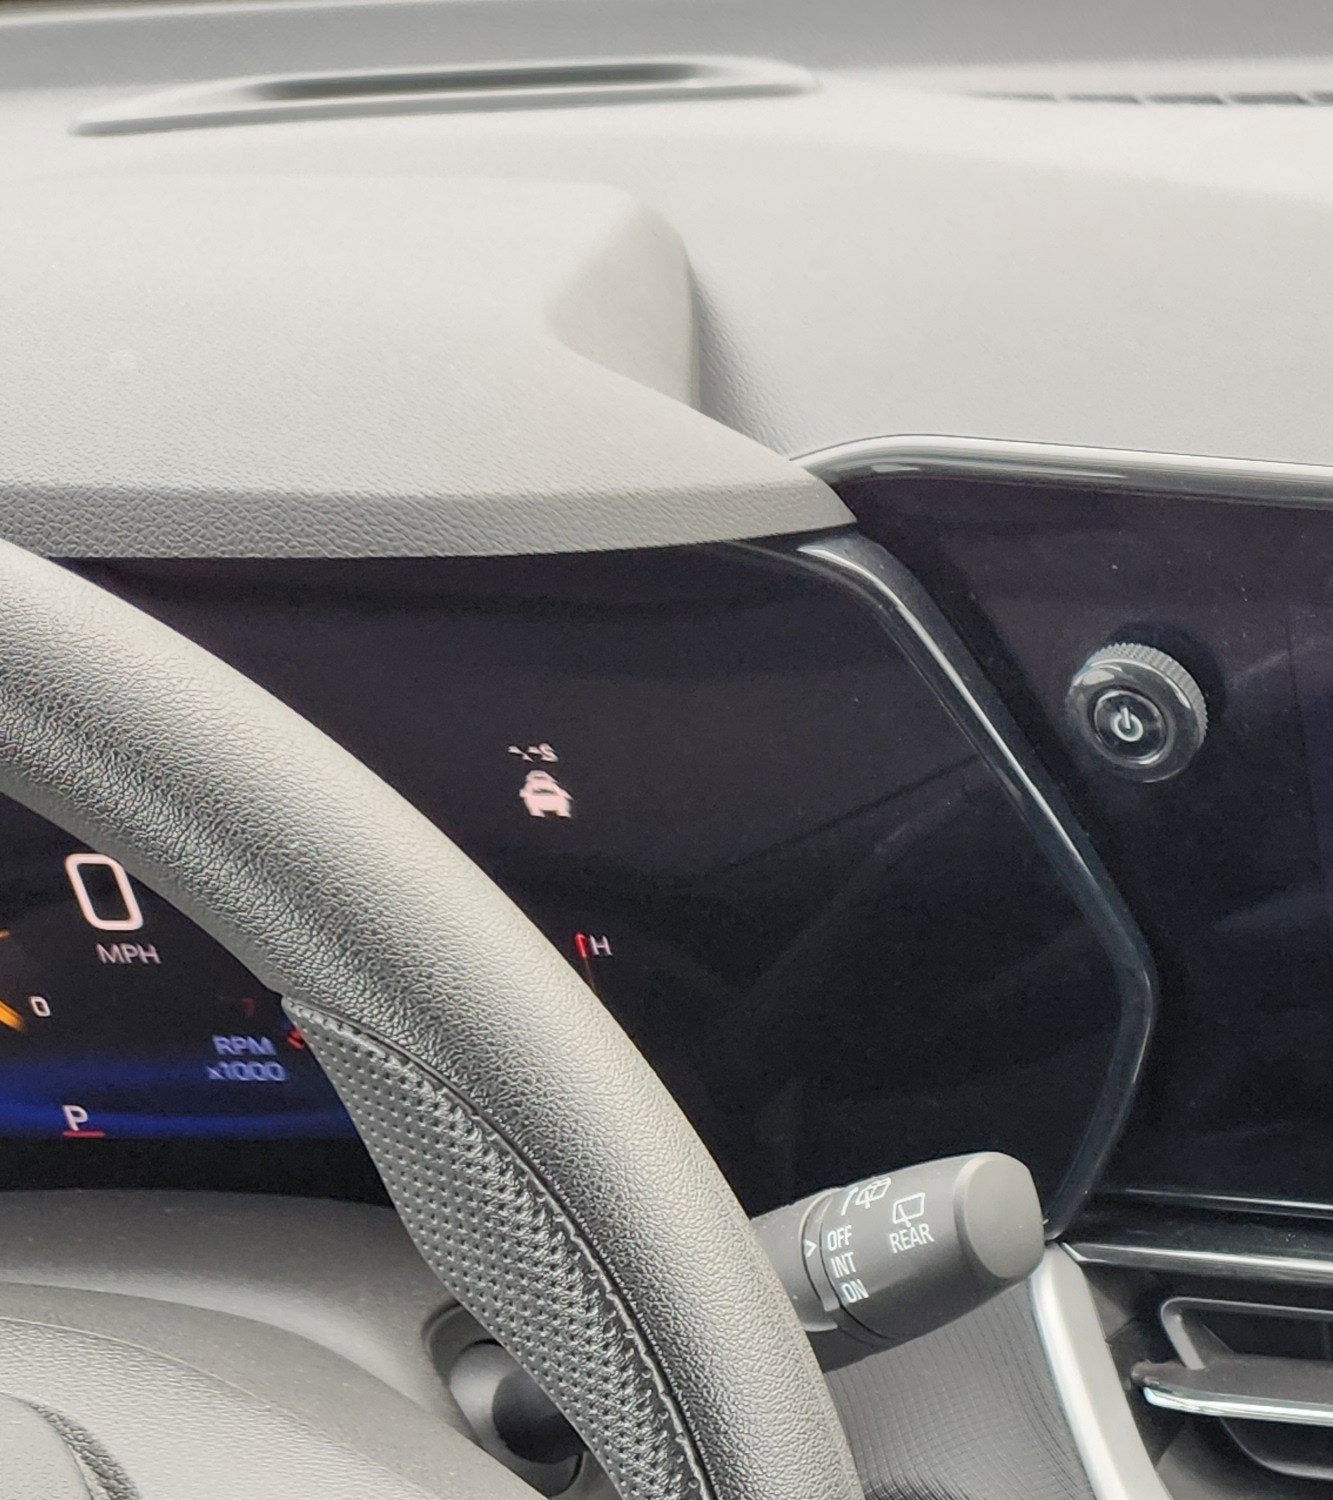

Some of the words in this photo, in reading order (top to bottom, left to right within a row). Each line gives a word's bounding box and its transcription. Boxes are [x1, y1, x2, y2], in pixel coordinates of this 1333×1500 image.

[64, 853, 144, 931] 0
[95, 943, 162, 965] MPH
[589, 935, 613, 957] H
[211, 1034, 277, 1056] RPM
[206, 1060, 288, 1082] x1000
[62, 1104, 90, 1131] P
[827, 1224, 853, 1252] OFF
[889, 1222, 935, 1254] REAR
[830, 1251, 857, 1279] INT
[841, 1278, 870, 1304] ON
